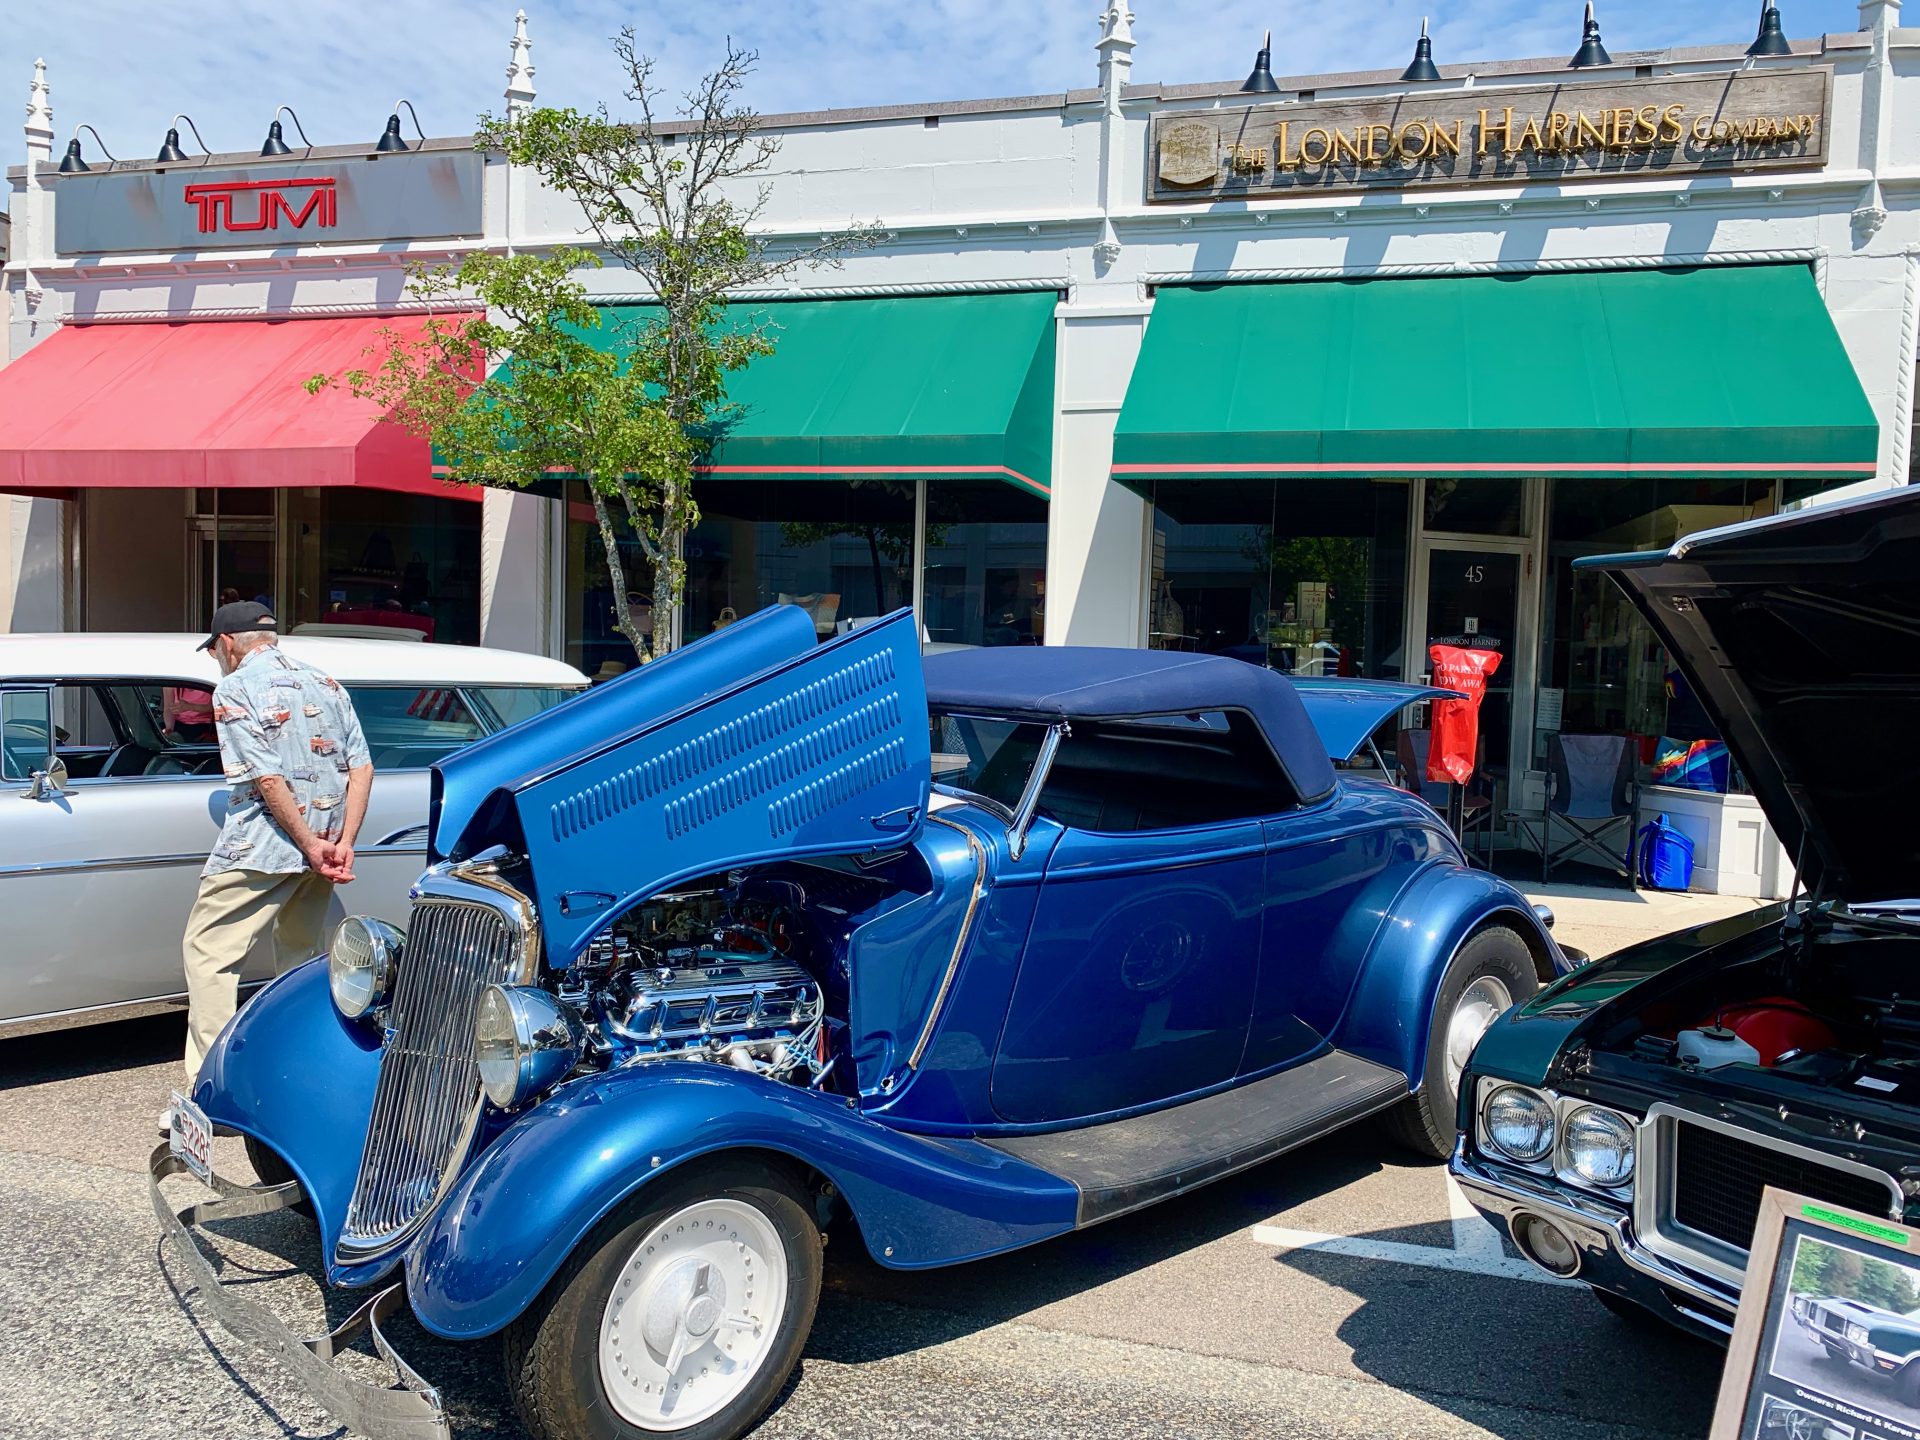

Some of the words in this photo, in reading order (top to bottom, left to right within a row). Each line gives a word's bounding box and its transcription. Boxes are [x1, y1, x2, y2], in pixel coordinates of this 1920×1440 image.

[1227, 144, 1267, 168] THE
[1277, 119, 1464, 166] LONDON
[1477, 103, 1685, 156] HARNESS
[1692, 114, 1822, 142] COMPANY
[185, 177, 337, 233] TUMI
[1465, 565, 1483, 583] 45
[1440, 637, 1469, 645] LONDON
[1471, 638, 1501, 646] HARNESS
[1449, 663, 1483, 675] PARKI
[1461, 678, 1482, 689] AWA
[1796, 1388, 1834, 1409] Owners:
[1836, 1403, 1873, 1423] Richard
[1874, 1418, 1882, 1427] &
[1883, 1421, 1913, 1438] Karen
